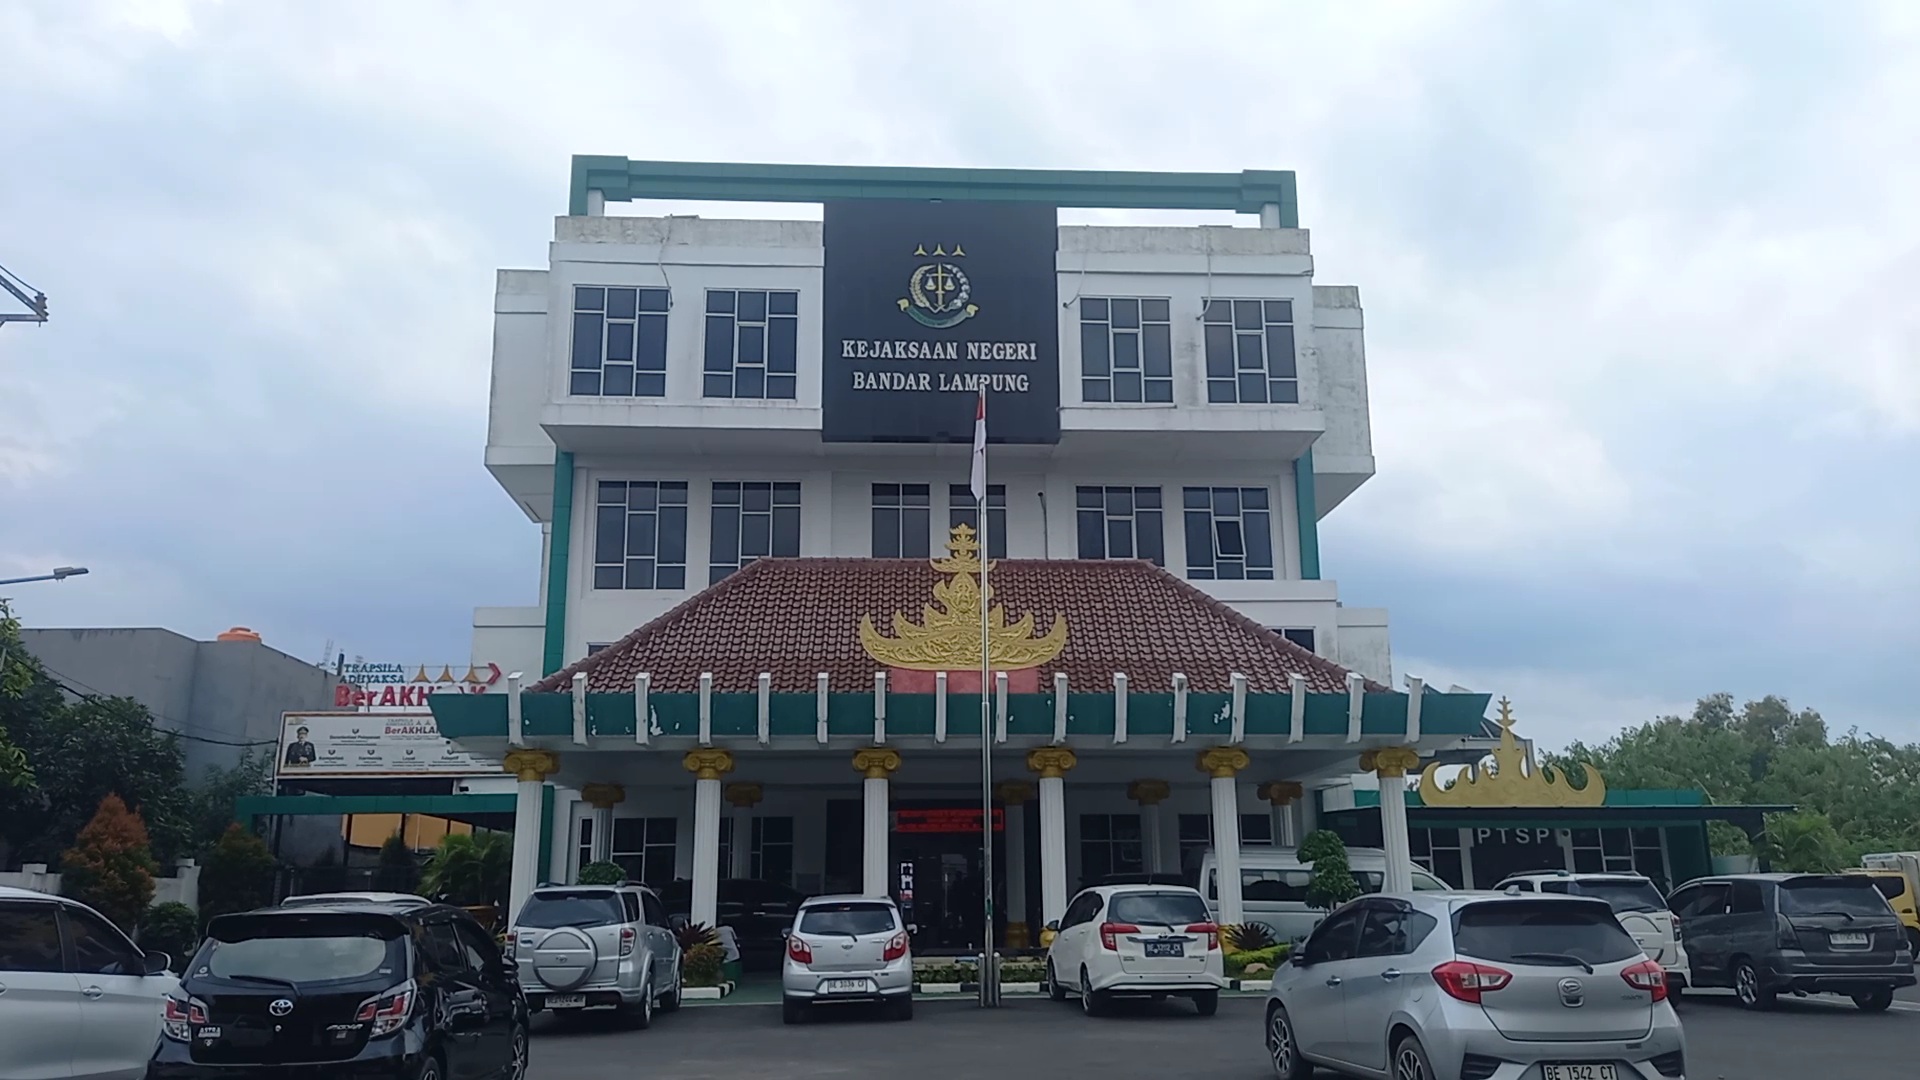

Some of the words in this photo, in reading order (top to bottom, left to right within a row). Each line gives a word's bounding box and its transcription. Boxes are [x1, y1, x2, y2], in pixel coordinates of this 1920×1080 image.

[841, 340, 958, 360] KEJAKSAAN
[966, 342, 1037, 361] NEGERI
[852, 371, 932, 391] BANDAR
[938, 373, 1029, 392] LAMPUNG
[343, 663, 403, 673] TRAPSILA
[339, 673, 405, 684] ADHYAKSA
[384, 726, 438, 735] BerAKHLA
[1477, 827, 1550, 844] PTSP
[1546, 1066, 1561, 1080] BE
[1566, 1066, 1595, 1080] 1542
[1600, 1066, 1613, 1080] CT
